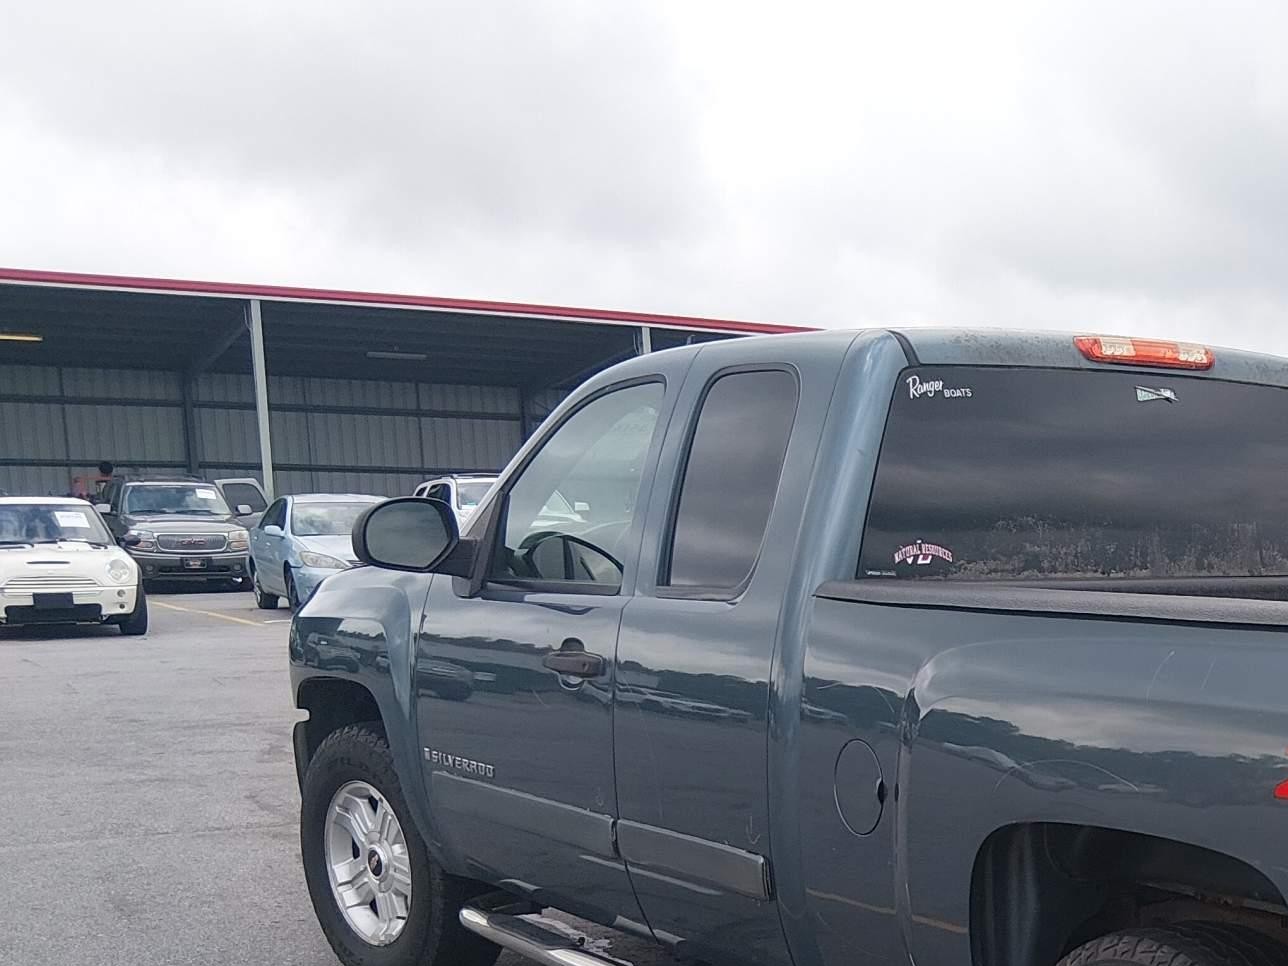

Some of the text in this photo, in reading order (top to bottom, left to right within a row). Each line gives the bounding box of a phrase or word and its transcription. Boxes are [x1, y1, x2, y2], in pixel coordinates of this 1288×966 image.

[906, 375, 972, 399] Ranger BOATS
[894, 544, 921, 564] NATURAL
[921, 543, 953, 563] RESOURCES
[431, 750, 495, 778] SILVERADO
